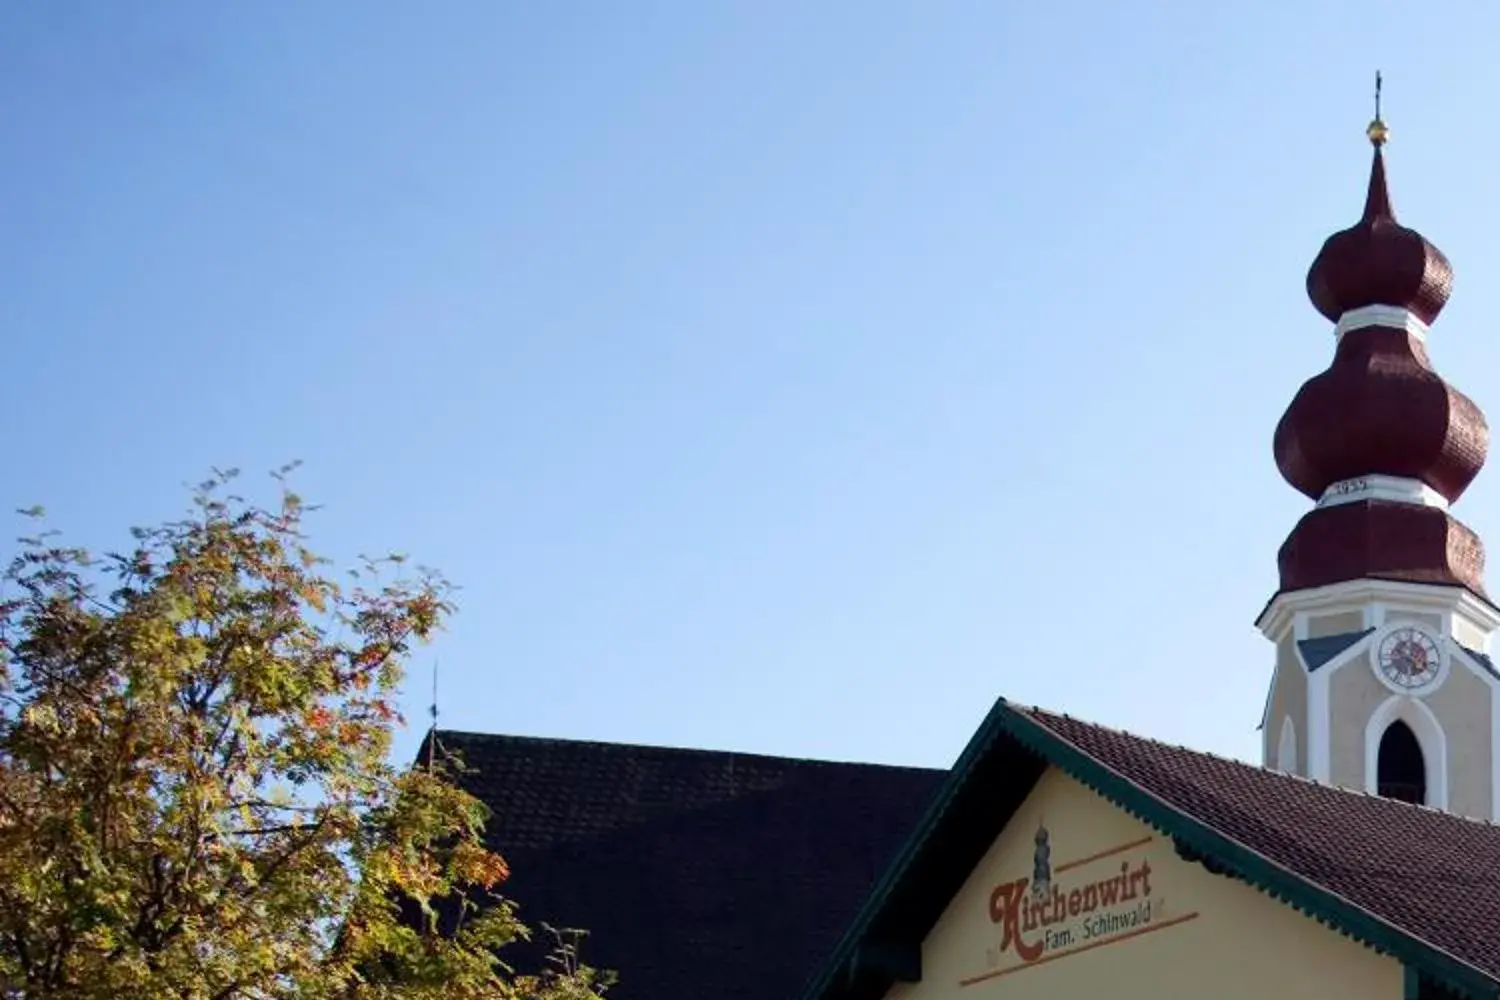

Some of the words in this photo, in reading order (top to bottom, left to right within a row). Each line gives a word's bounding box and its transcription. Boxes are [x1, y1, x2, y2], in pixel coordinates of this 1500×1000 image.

[989, 858, 1152, 961] Kirchenwirt
[1044, 928, 1075, 950] Fam.
[1083, 903, 1152, 940] Schinwald
